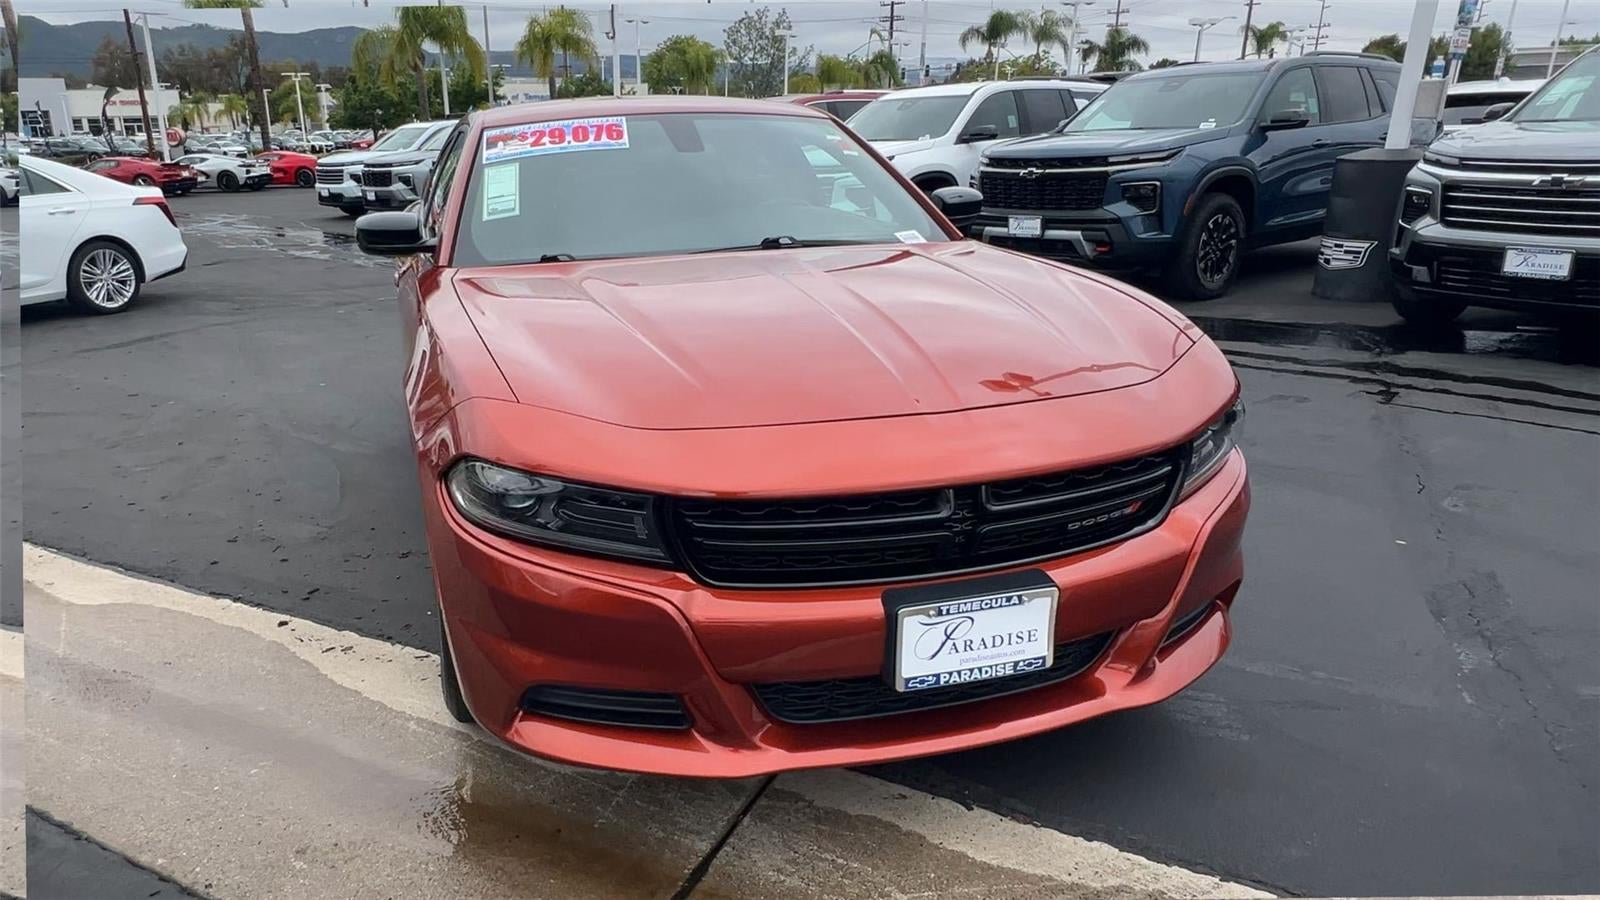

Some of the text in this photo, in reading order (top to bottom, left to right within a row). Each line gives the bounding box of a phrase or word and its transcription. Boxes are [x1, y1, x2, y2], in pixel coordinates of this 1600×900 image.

[1067, 508, 1130, 530] DODGE
[940, 595, 1019, 615] TEMECULA
[914, 616, 1039, 661] PARADISE
[940, 661, 1014, 685] PARADISE
